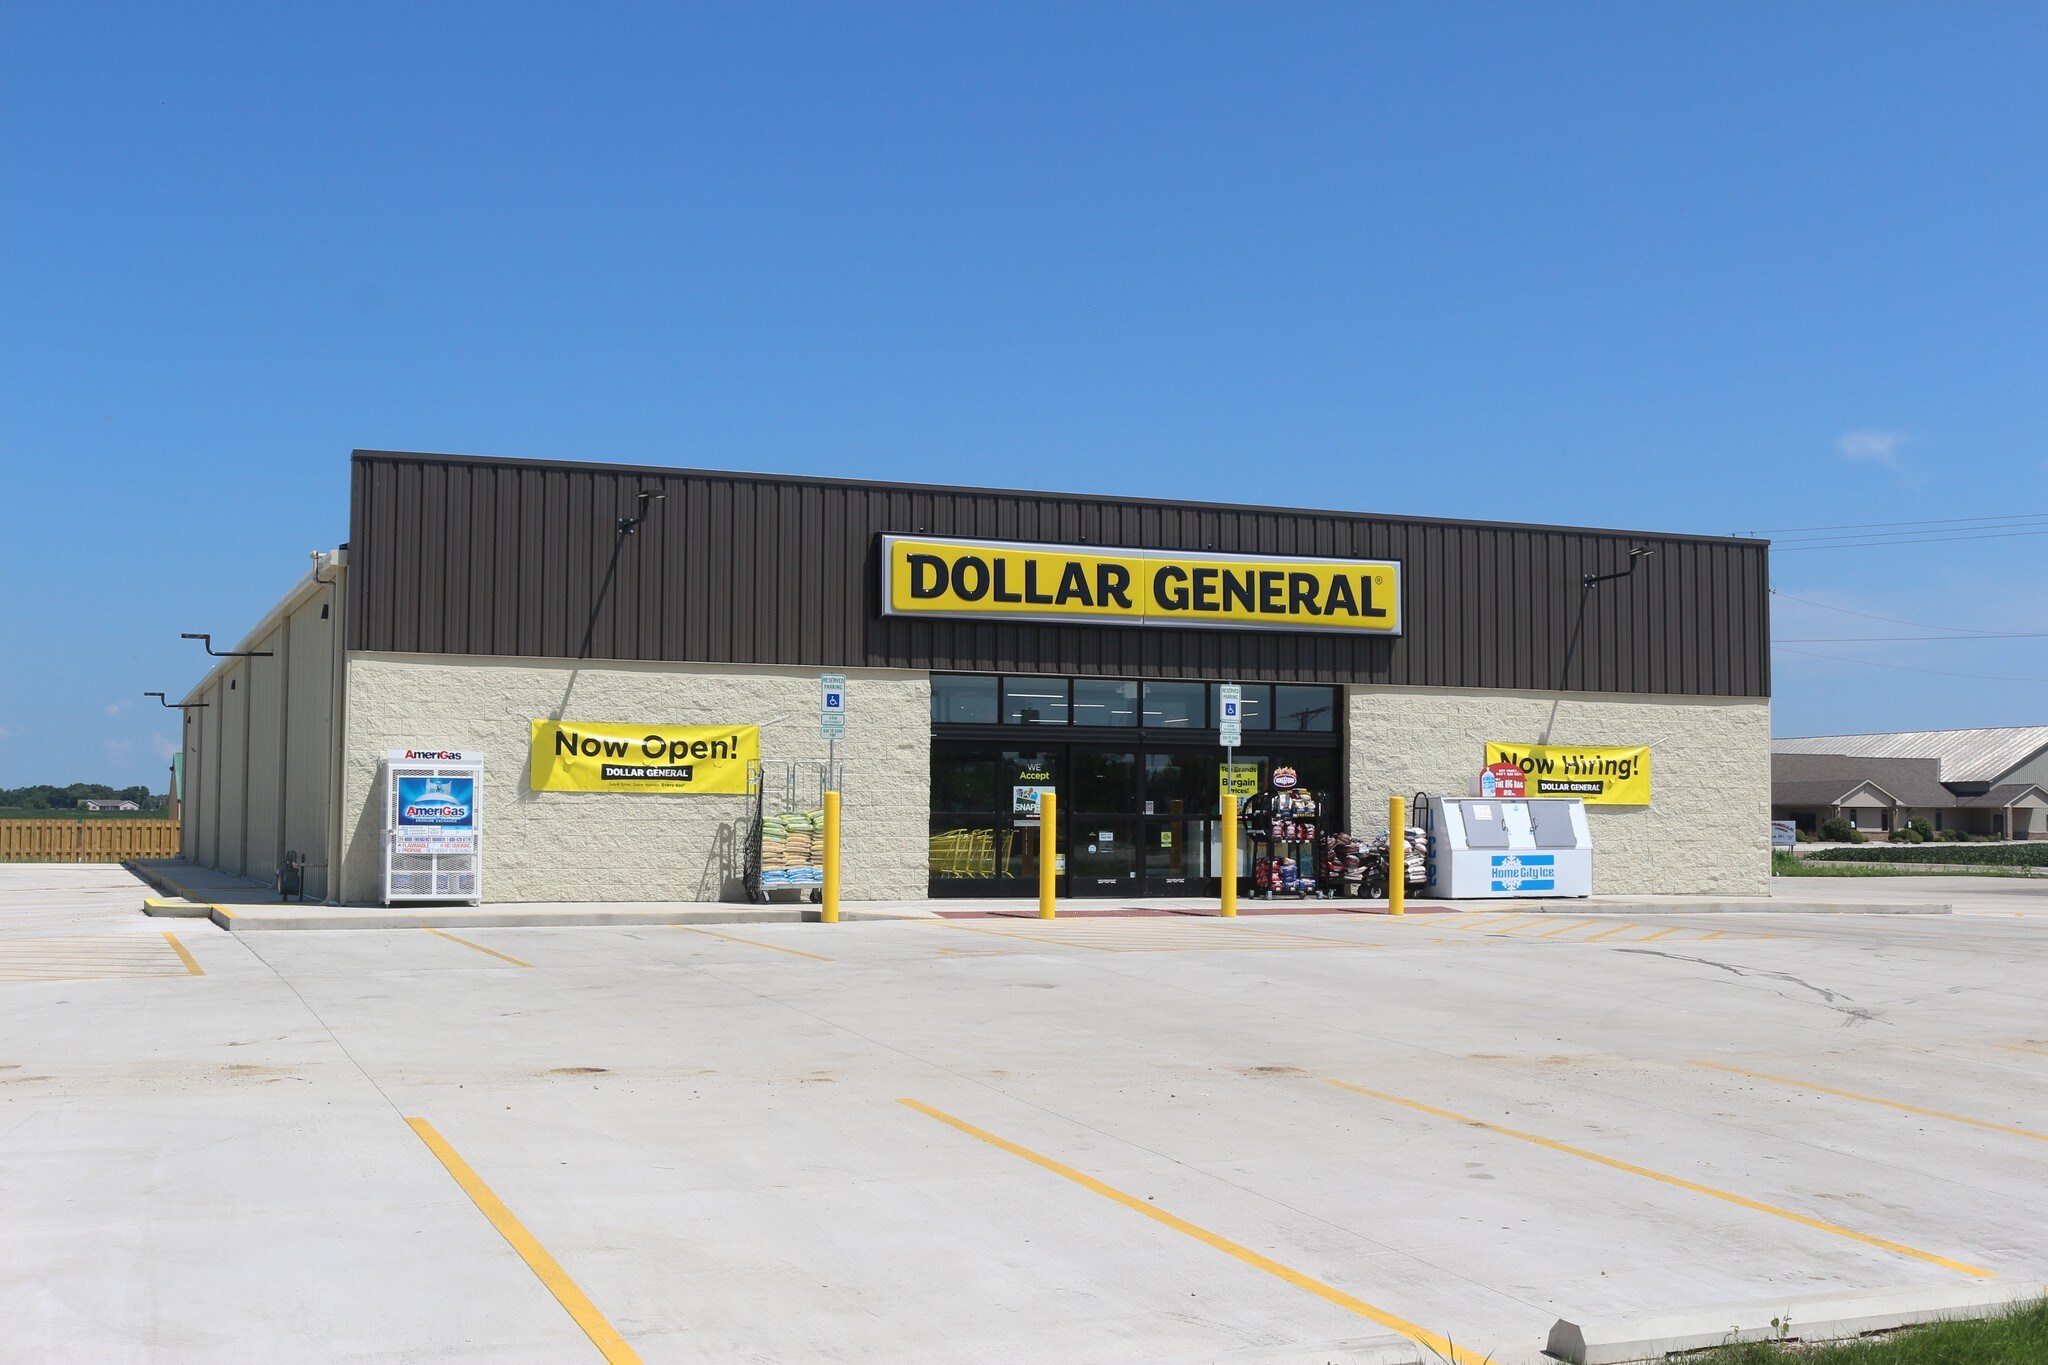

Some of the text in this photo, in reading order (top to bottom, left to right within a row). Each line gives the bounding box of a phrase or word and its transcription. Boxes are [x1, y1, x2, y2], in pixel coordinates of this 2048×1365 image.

[907, 553, 1133, 609] DOLLAR
[555, 730, 738, 763] Now Open!
[405, 750, 462, 760] AmeriGas
[1562, 755, 1639, 779] Hiring!
[605, 768, 689, 777] DOLLAR GENERAL
[1020, 771, 1050, 781] Accept
[1505, 779, 1513, 788] BIG
[1514, 780, 1524, 788] BAG
[1541, 782, 1601, 791] DOLLAR GENERAL
[407, 806, 465, 816] AmeriGas
[1015, 803, 1036, 811] SNAP
[1491, 867, 1554, 880] Home City Ice
